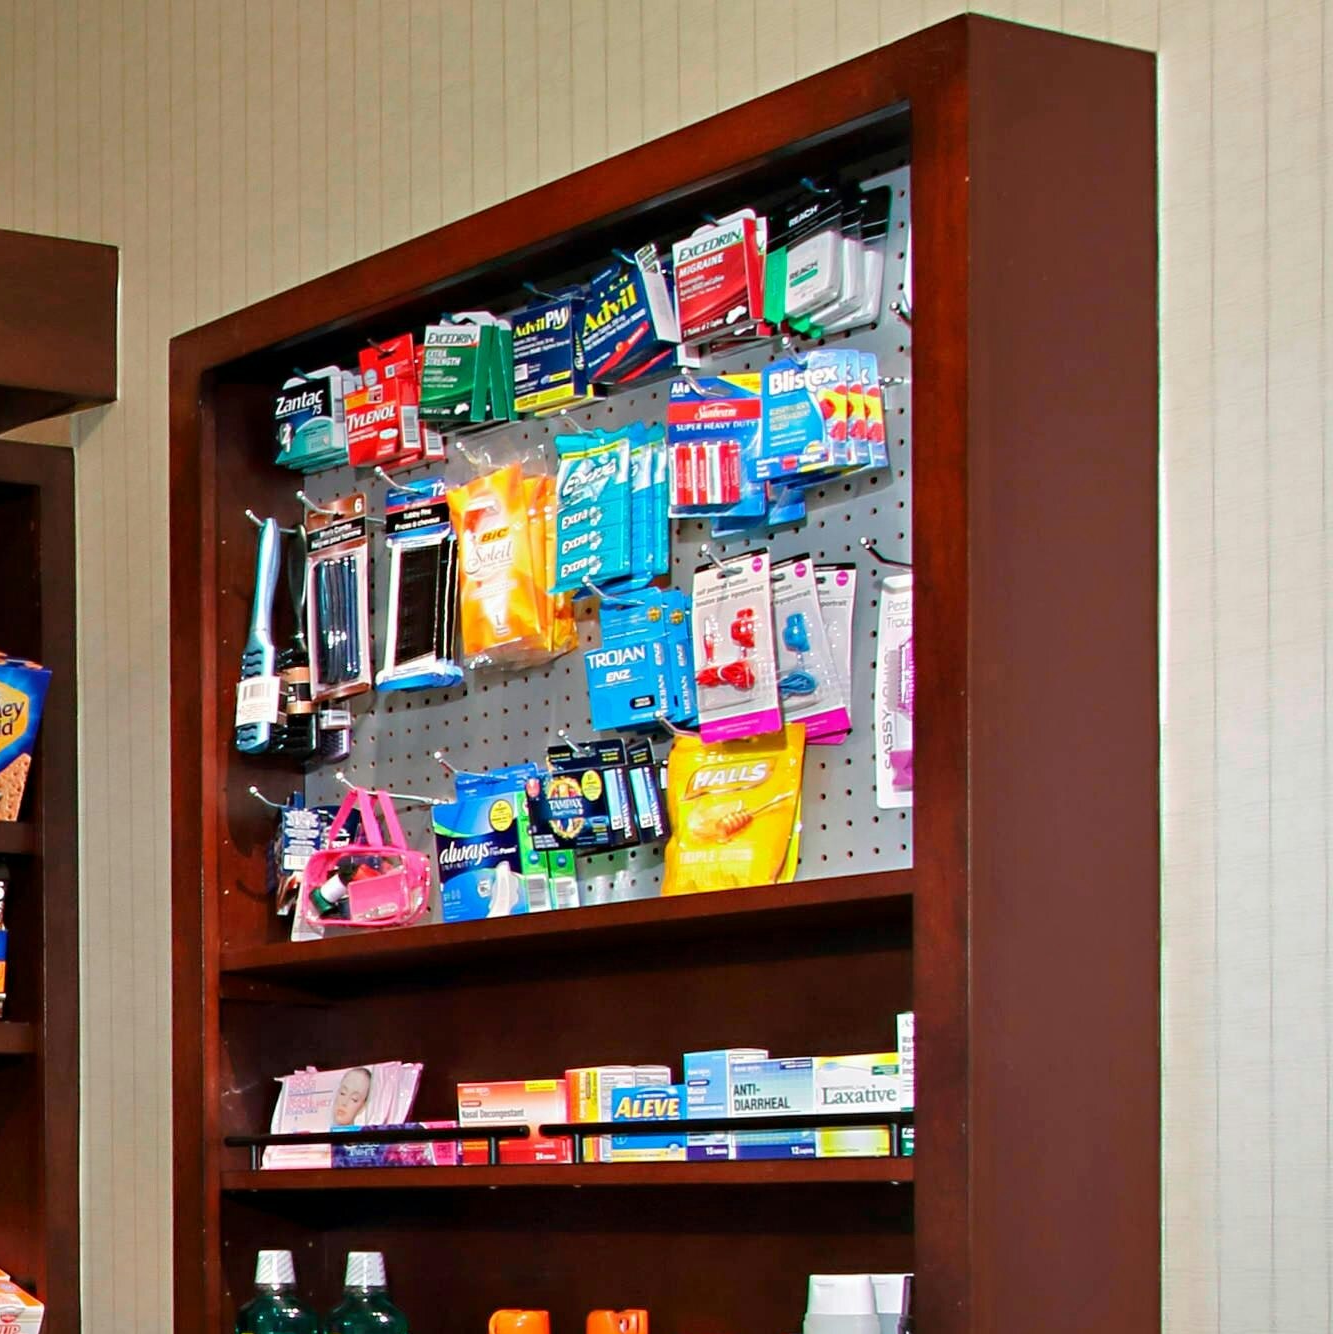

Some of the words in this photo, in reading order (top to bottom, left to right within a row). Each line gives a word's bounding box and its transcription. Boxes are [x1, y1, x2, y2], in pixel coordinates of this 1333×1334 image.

[788, 204, 819, 228] REACH
[677, 228, 743, 263] EXCEDRIN
[678, 252, 725, 279] MIGRAINE
[788, 260, 819, 281] REACH
[582, 283, 638, 336] Advil
[514, 319, 545, 338] Advil
[544, 306, 569, 329] PM
[426, 331, 478, 346] EXCEDRIN
[768, 365, 839, 395] Blistex
[275, 389, 324, 415] Zantac
[312, 404, 322, 416] 75
[694, 405, 738, 421] Sunbeam
[347, 404, 397, 431] TYLENOL
[676, 422, 702, 432] SUPER
[707, 421, 731, 430] HEAVY
[432, 482, 446, 497] 72
[354, 497, 362, 513] 6
[464, 540, 514, 574] Soleil
[588, 646, 646, 669] TROJAN
[605, 669, 632, 683] ENZ
[692, 763, 770, 791] HALLS
[549, 798, 581, 812] TAMPAX
[439, 840, 490, 866] always
[733, 1083, 761, 1099] ANTI-
[821, 1085, 897, 1106] Laxative
[461, 1109, 478, 1119] Nasal
[479, 1108, 525, 1120] Decongestant
[614, 1096, 680, 1119] ALEVE
[733, 1096, 790, 1111] DIARRHEAL
